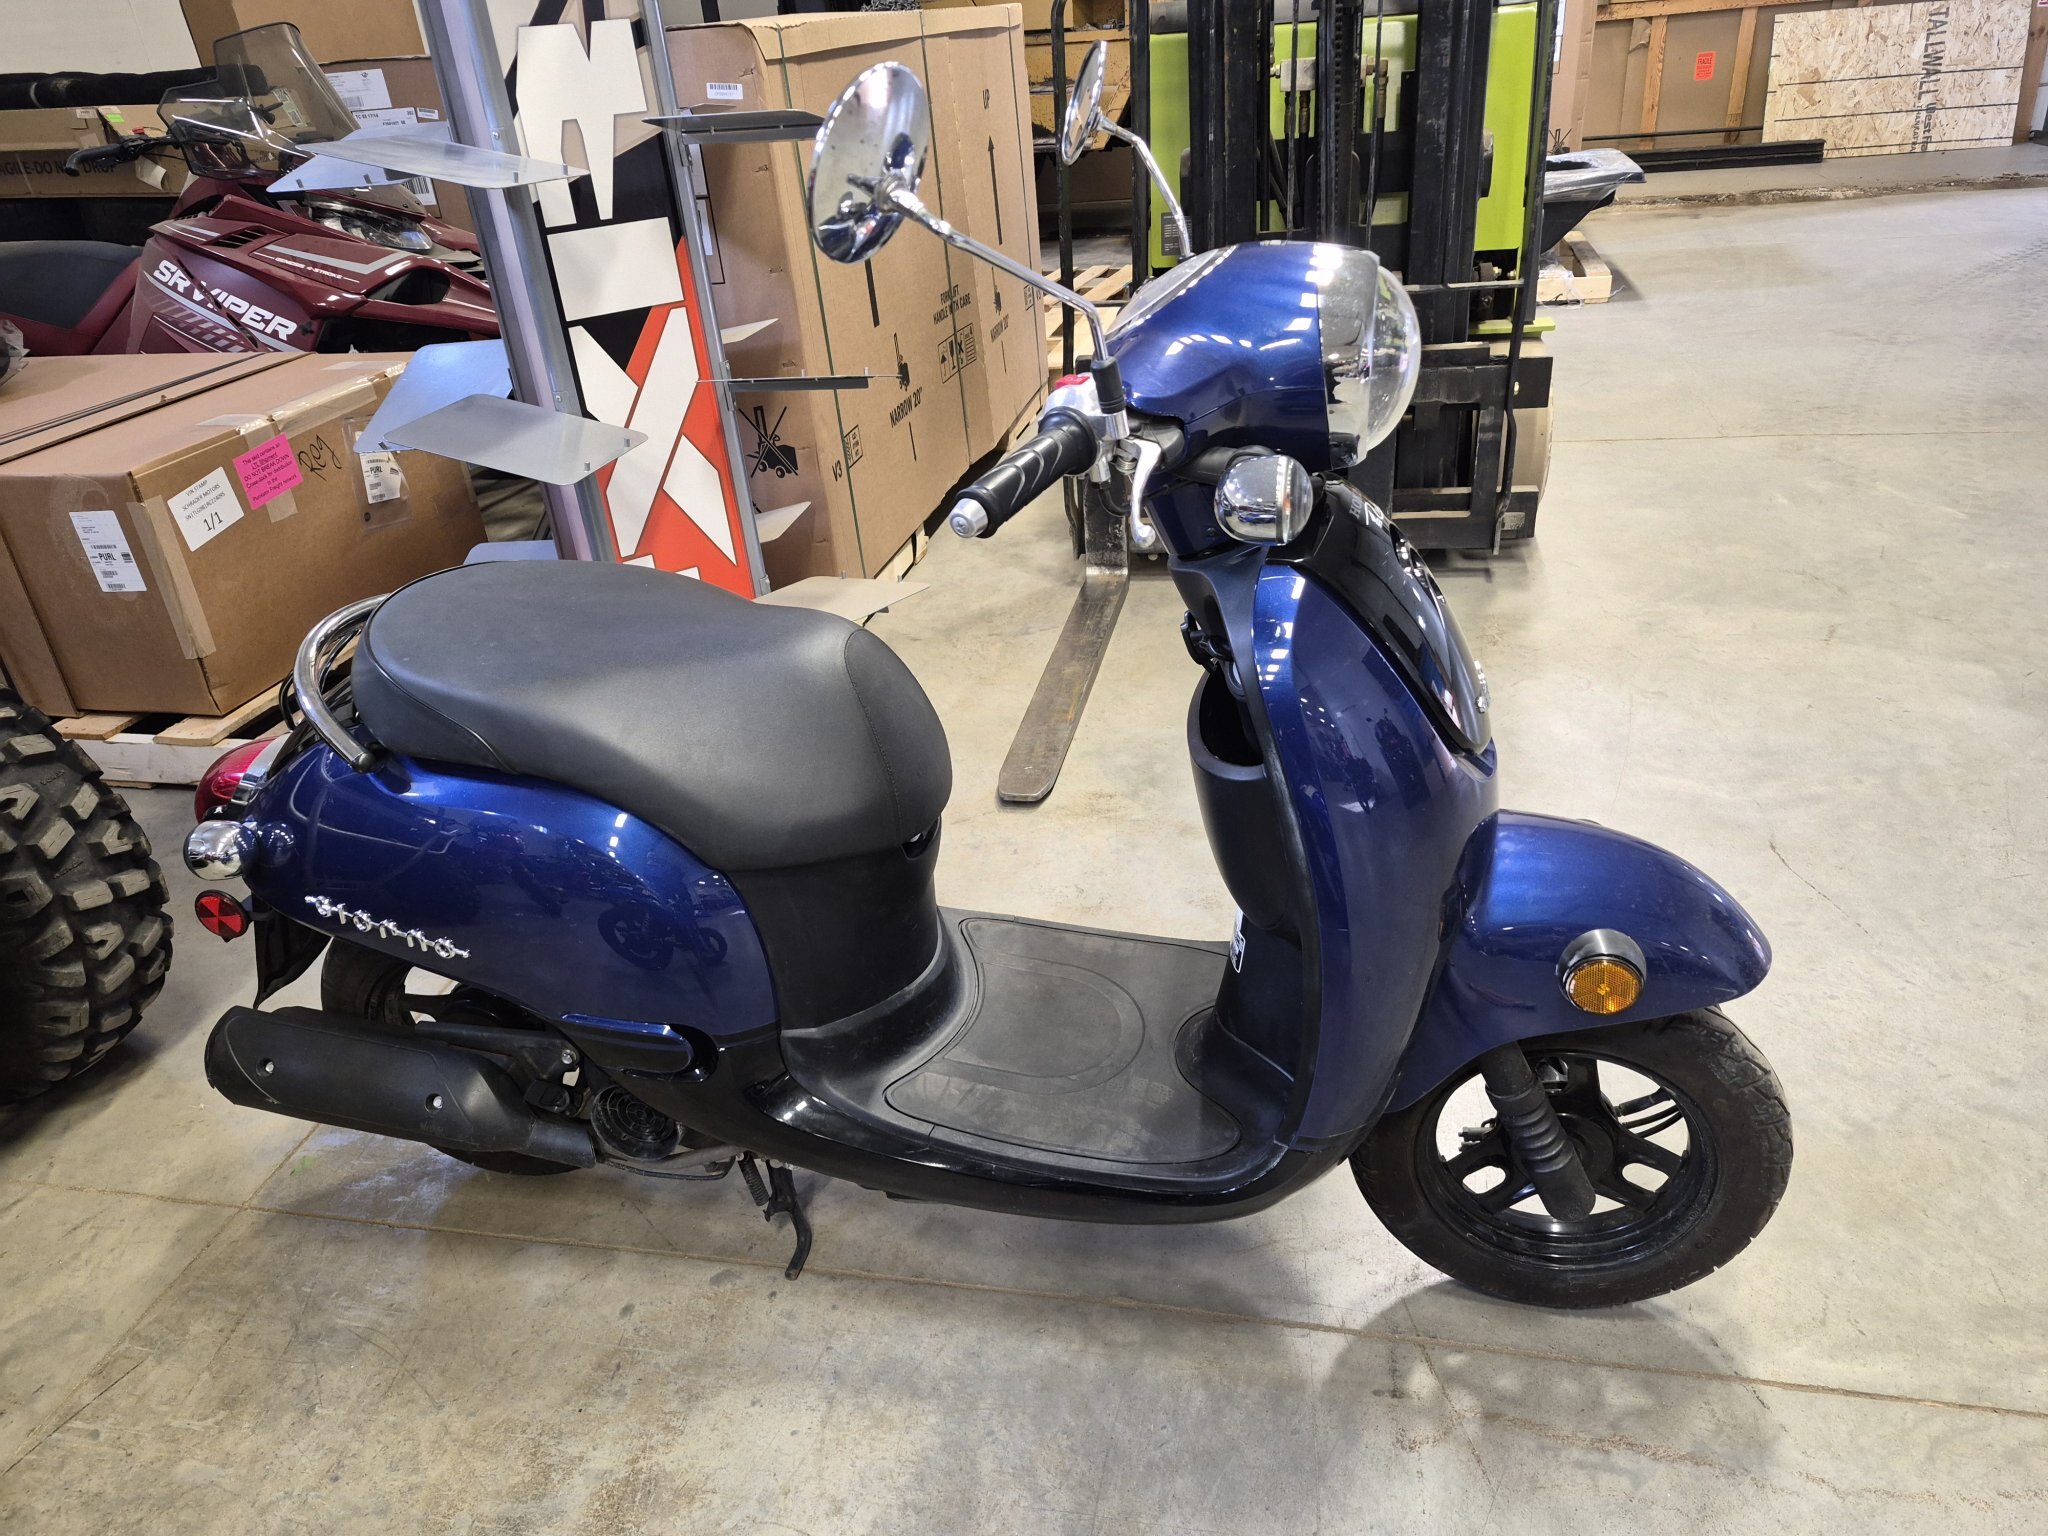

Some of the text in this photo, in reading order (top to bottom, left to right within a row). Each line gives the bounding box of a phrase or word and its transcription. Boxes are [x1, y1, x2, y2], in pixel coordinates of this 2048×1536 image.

[1918, 7, 1950, 100] TALLWALL
[982, 88, 990, 110] UP
[1923, 102, 1937, 134] West
[153, 259, 298, 341] SR VIPER
[933, 306, 949, 325] HANDLE
[959, 292, 971, 308] CARE
[889, 395, 913, 428] NARROW
[243, 454, 290, 482] DO NOT BREAK DOWN
[370, 466, 383, 475] PURL
[832, 459, 843, 482] V3
[182, 483, 221, 512] SCHRADER MOTORS
[185, 479, 208, 497] VIN STAMP
[203, 511, 223, 531] 1/1
[98, 552, 117, 561] PURL
